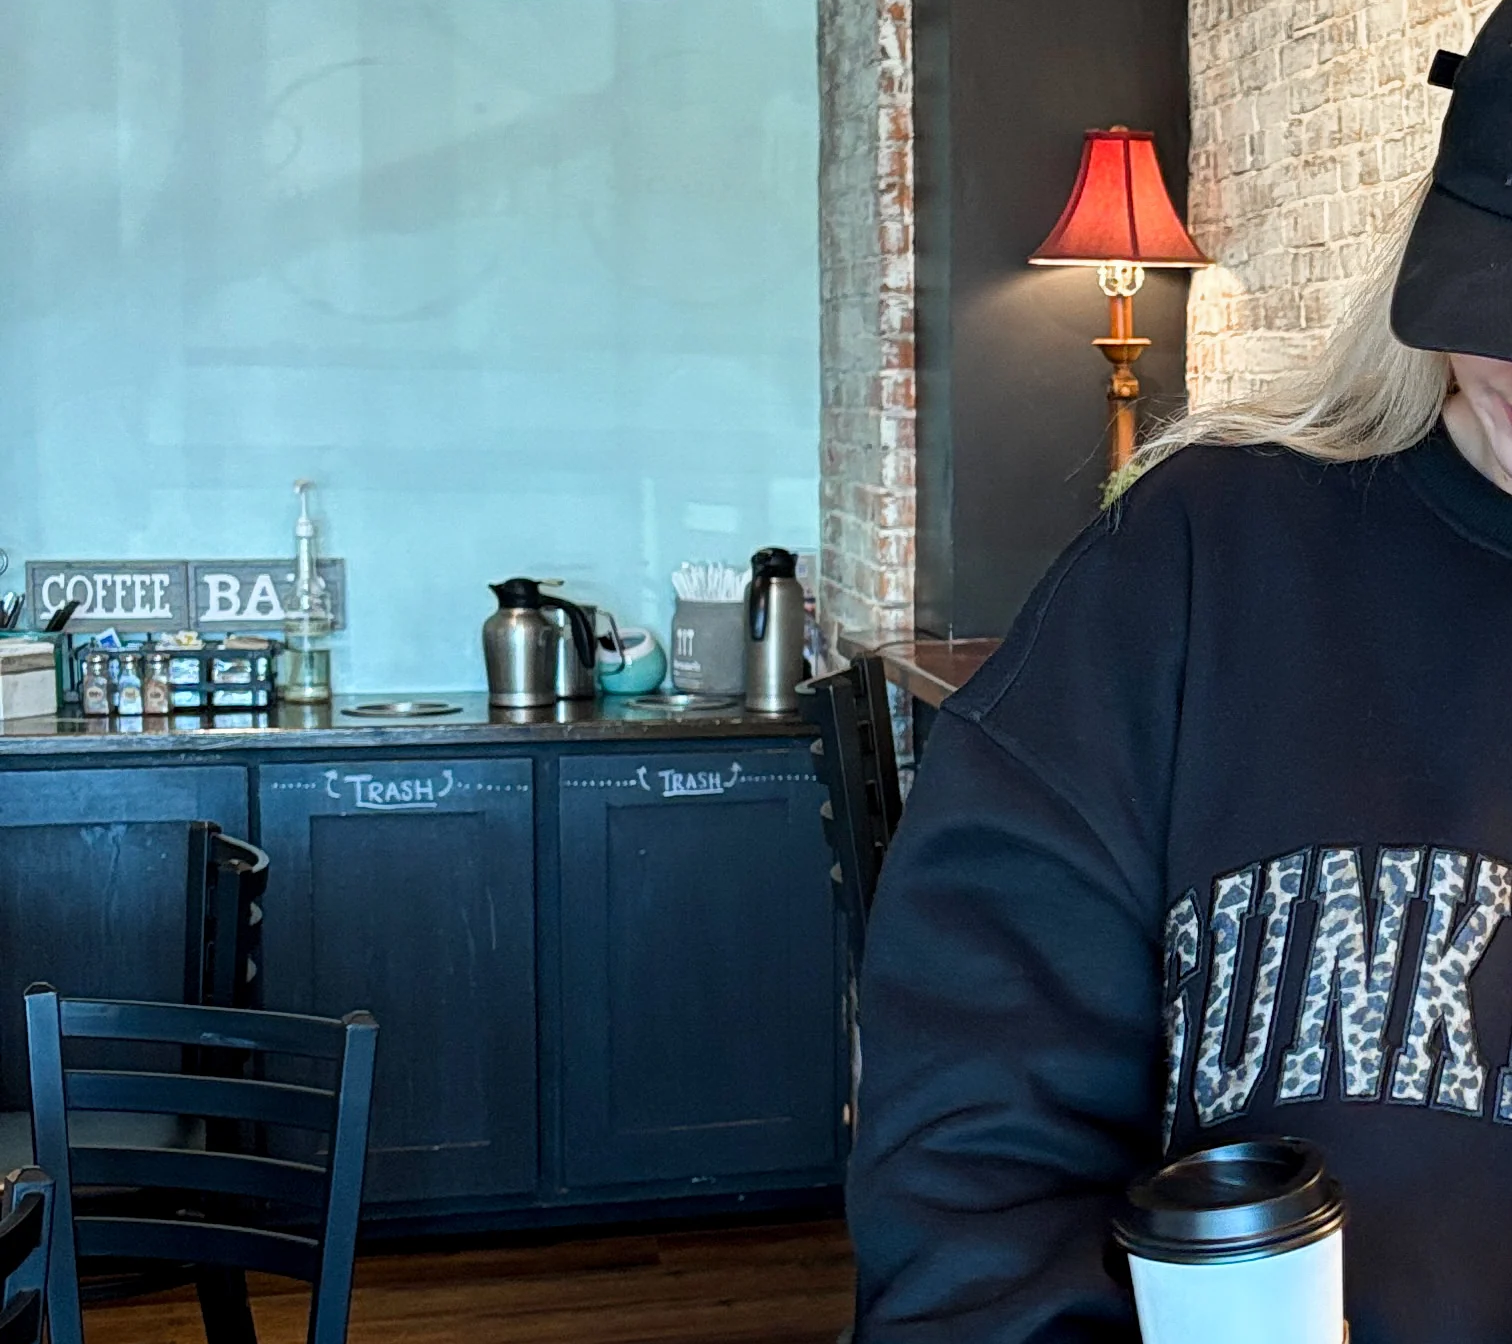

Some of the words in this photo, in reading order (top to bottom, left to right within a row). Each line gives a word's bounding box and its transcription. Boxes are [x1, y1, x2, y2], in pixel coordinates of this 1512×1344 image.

[40, 572, 173, 621] COFFEE
[344, 773, 437, 807] TRASH
[658, 768, 723, 795] TRASH
